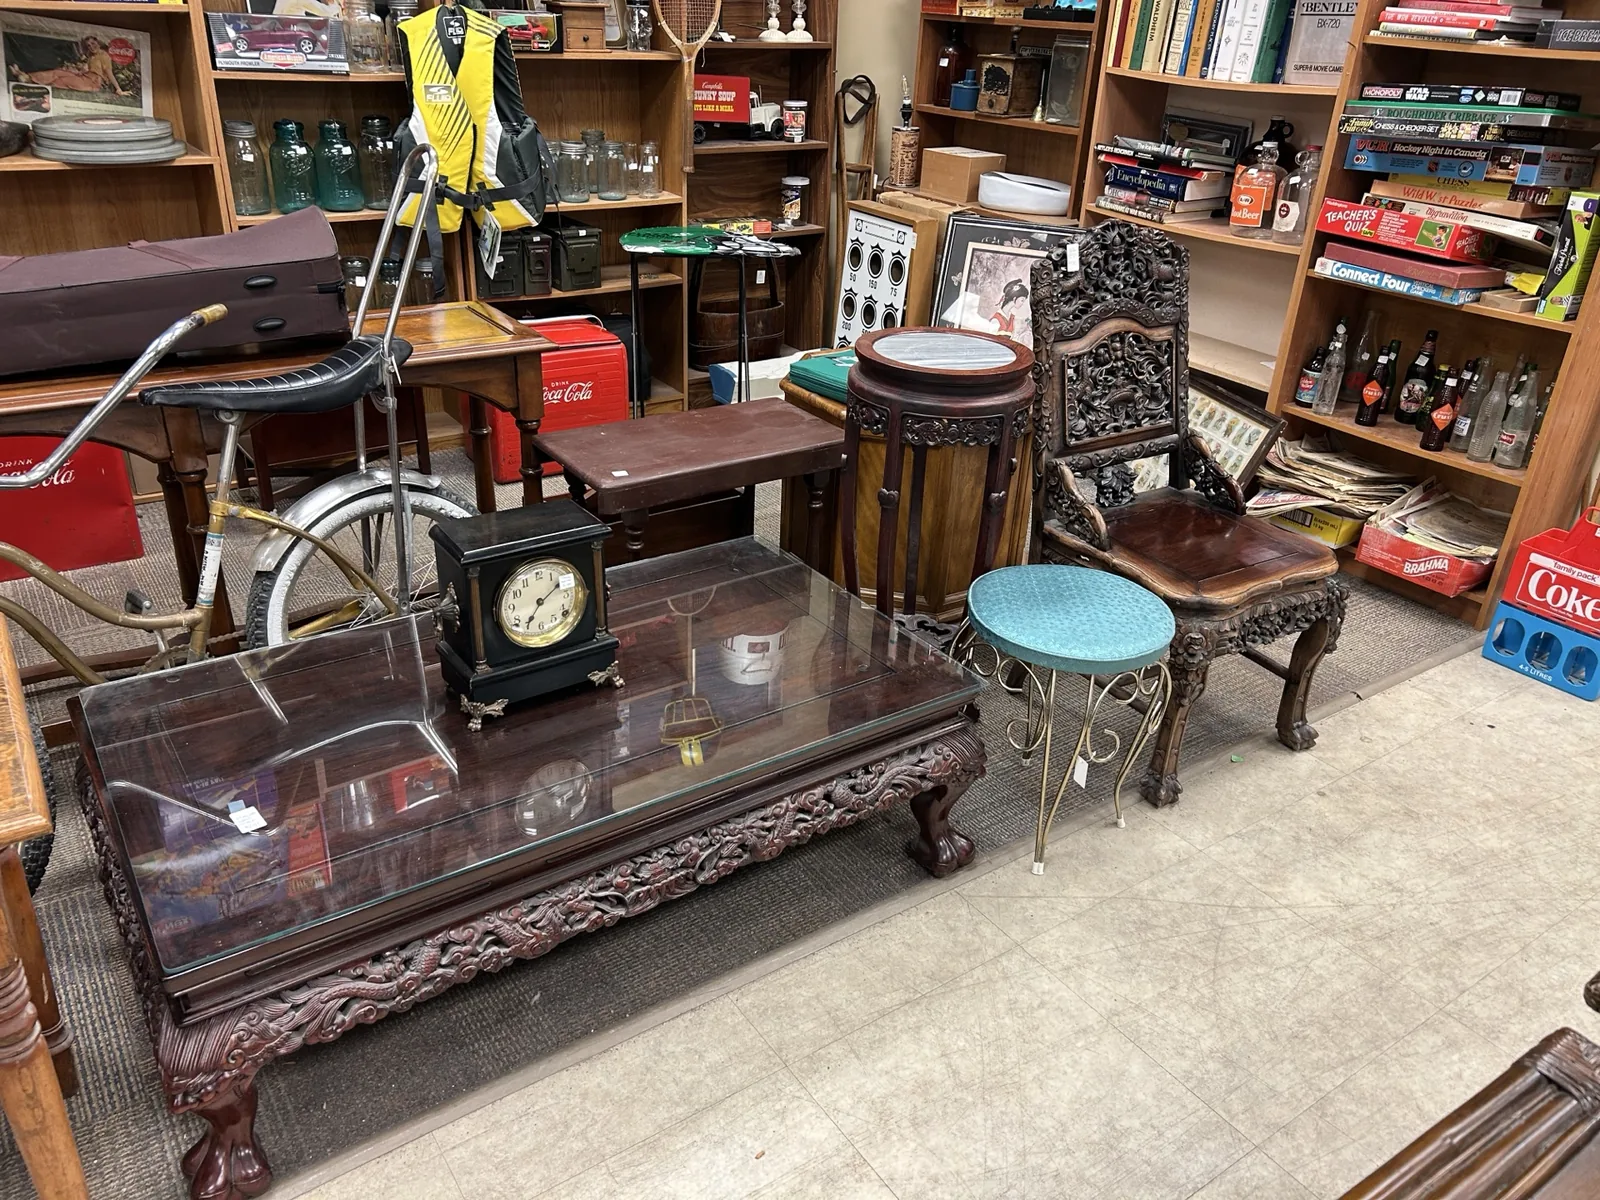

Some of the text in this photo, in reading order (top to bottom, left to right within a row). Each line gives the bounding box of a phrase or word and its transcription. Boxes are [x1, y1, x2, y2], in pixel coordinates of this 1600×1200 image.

[1148, 0, 1161, 42] WALDHEIM
[1317, 18, 1341, 29] BX-720
[1384, 12, 1394, 20] THE
[1410, 14, 1438, 24] REVEALED
[1207, 31, 1215, 51] PLACES
[1557, 28, 1574, 42] ICE
[694, 90, 737, 102] HUNKY SOUP
[1364, 88, 1401, 97] MONOPOLY
[703, 104, 715, 112] LIKE
[1387, 109, 1447, 120] ROUGHRIDER
[1448, 111, 1498, 123] CRIBBAGE
[1375, 121, 1395, 130] CHESS
[1399, 124, 1428, 132] CHECKER
[1428, 124, 1440, 133] SET
[1356, 139, 1389, 152] VCR
[1393, 143, 1488, 158] Hockey Night in Canada
[1116, 169, 1166, 191] Encyclopedia
[1437, 176, 1470, 187] CHESS
[1403, 186, 1483, 210] Wild Wst Puzzles
[1243, 209, 1260, 220] Beer
[1325, 209, 1378, 224] TEACHER'S
[1344, 220, 1371, 233] QUIZ
[1332, 262, 1380, 286] Connect
[1381, 273, 1411, 293] Four
[850, 272, 898, 297] 50 150 75
[842, 320, 852, 332] 200
[551, 380, 570, 388] DRINK
[543, 381, 595, 405] oca-Cola
[1403, 558, 1449, 574] BRAHMA
[535, 570, 543, 581] 12
[549, 572, 553, 582] 1
[522, 578, 529, 588] 11
[512, 588, 522, 600] 10
[563, 590, 570, 599] 3
[1528, 568, 1600, 622] Coke
[508, 603, 516, 613] 9
[550, 614, 557, 623] 5
[538, 621, 545, 630] 6
[1530, 667, 1553, 682] LITRES
